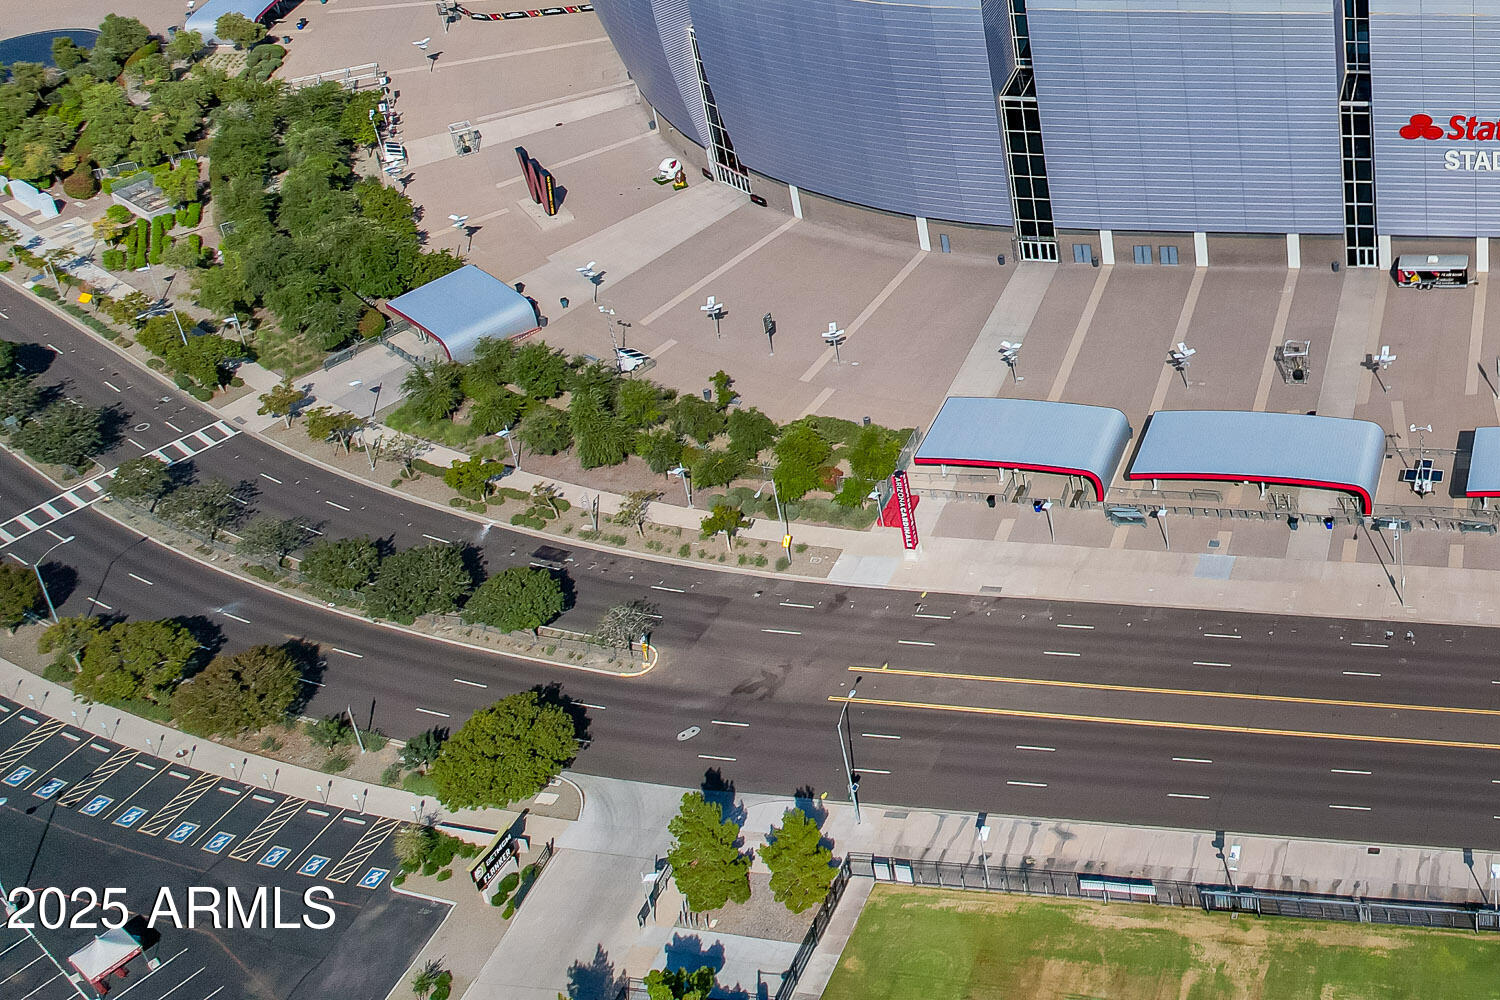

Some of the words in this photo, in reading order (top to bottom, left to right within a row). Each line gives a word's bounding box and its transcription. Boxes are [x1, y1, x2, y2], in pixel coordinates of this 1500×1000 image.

[895, 477, 905, 508] ARIZONA
[901, 507, 913, 547] CARDINALS
[483, 848, 511, 883] FLANKER
